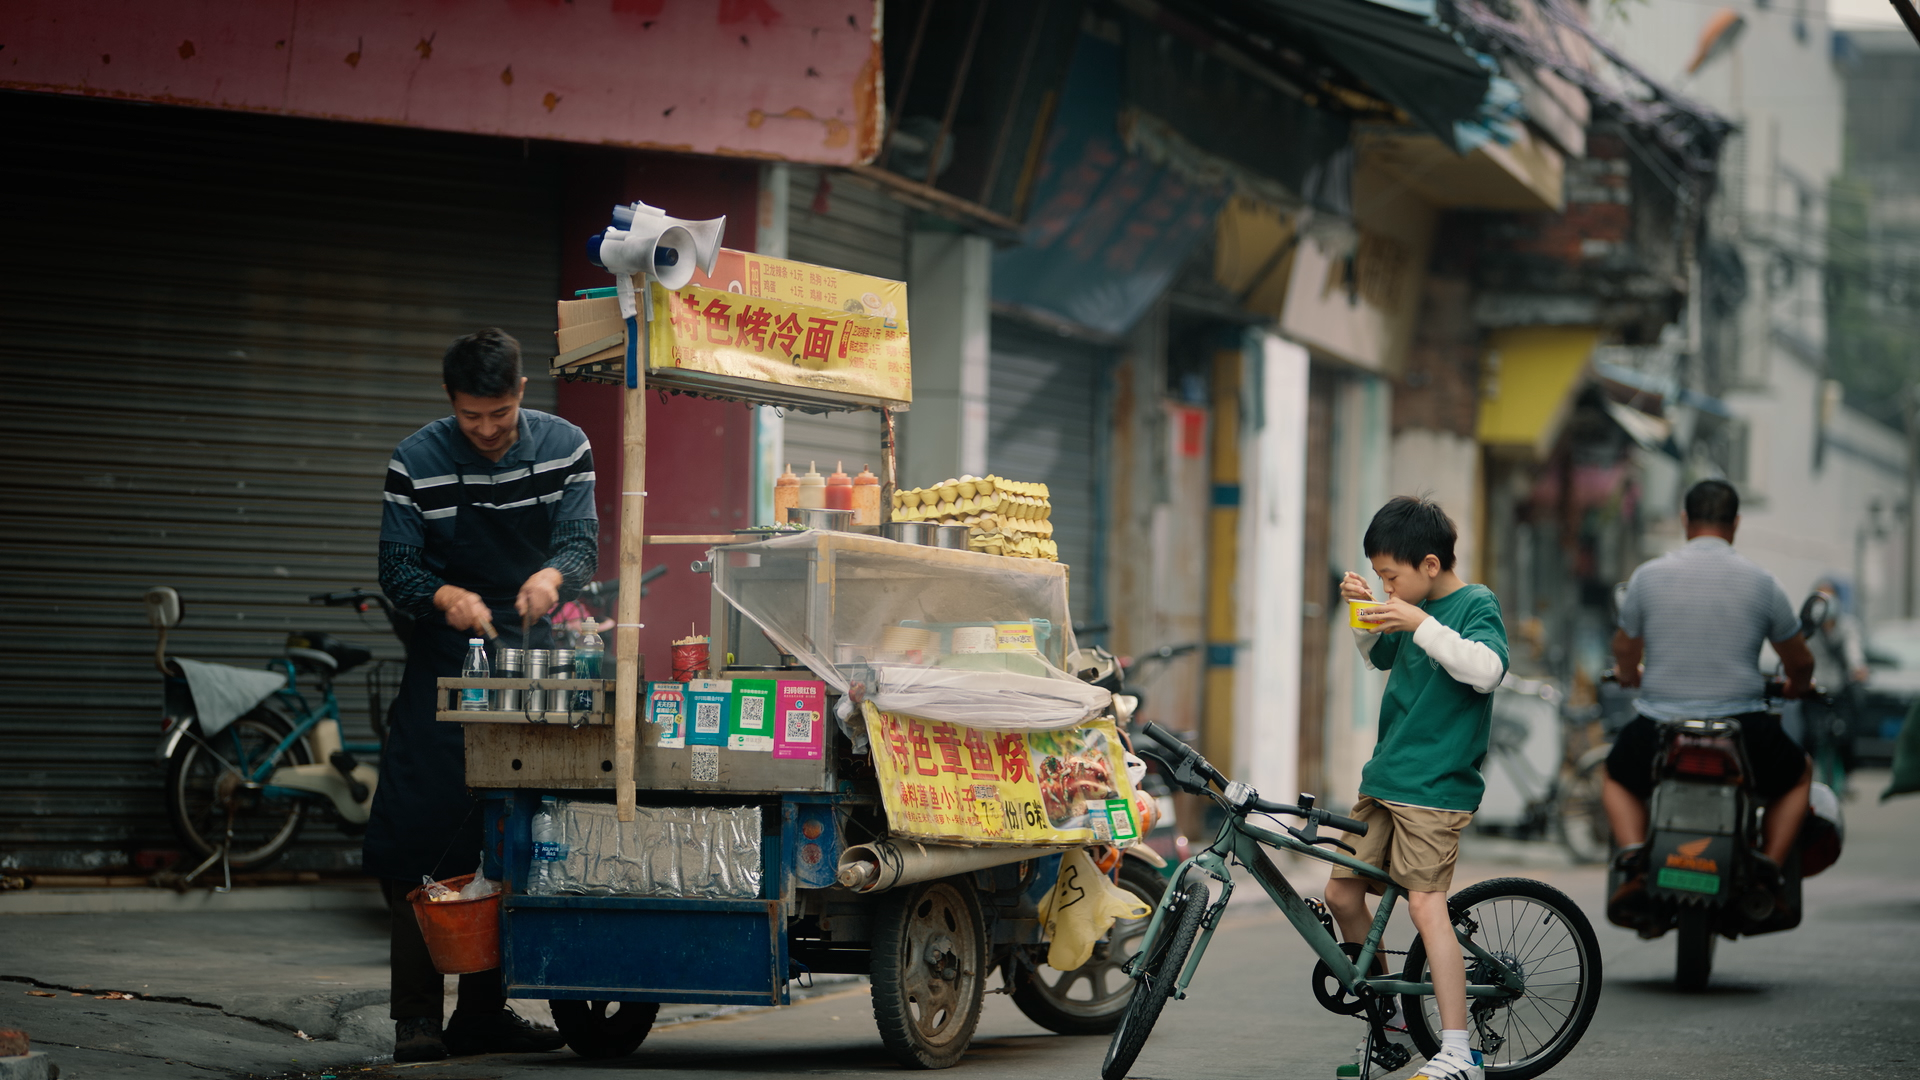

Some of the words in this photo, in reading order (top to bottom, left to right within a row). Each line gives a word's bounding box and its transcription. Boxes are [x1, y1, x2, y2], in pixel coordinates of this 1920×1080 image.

[669, 291, 839, 362] 特色烤冷面
[784, 686, 816, 695] 扫码领红包
[881, 714, 1034, 784] 特色章鱼烧
